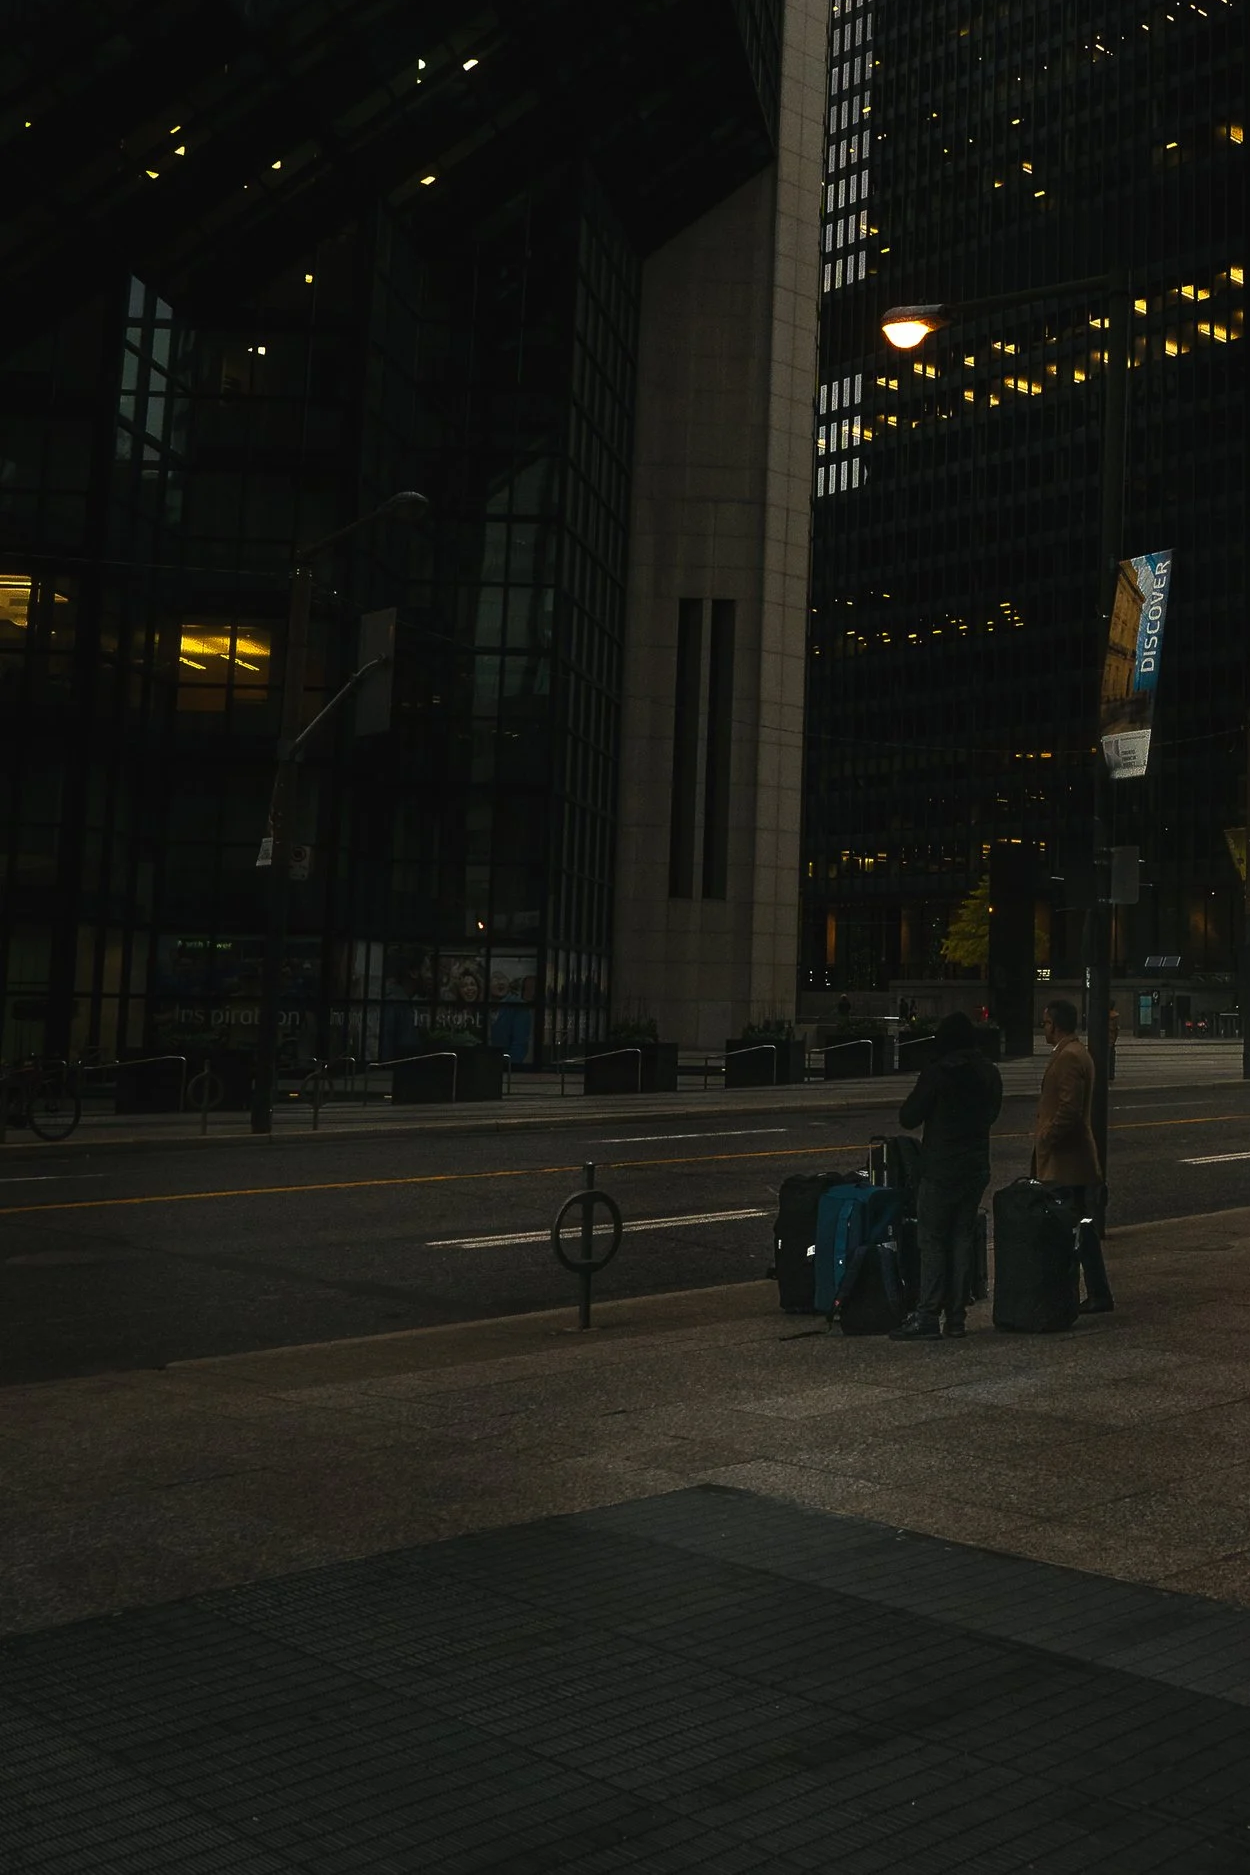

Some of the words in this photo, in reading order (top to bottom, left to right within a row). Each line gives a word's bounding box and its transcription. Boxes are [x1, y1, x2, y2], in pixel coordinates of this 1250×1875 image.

[1140, 560, 1171, 673] DISCOVER
[206, 940, 232, 950] Twer
[176, 1003, 299, 1028] Inspiraton
